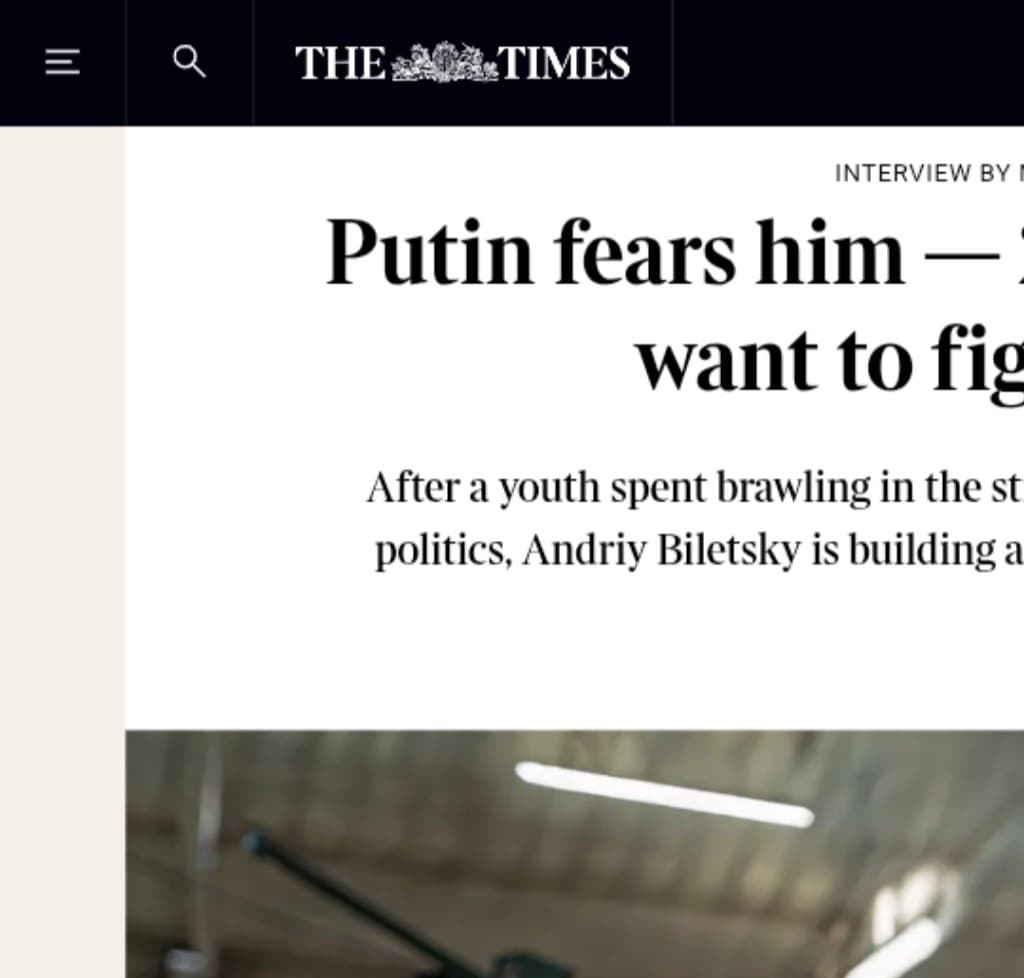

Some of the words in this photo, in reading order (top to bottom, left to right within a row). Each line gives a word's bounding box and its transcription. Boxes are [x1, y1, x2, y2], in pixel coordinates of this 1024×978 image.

[295, 45, 387, 81] THE
[497, 45, 631, 81] TIMES
[836, 164, 971, 182] INTERVIEW
[981, 164, 1010, 182] BY
[326, 217, 535, 285] Putin
[553, 217, 736, 286] fears
[756, 217, 906, 284] him
[633, 331, 818, 392] want
[837, 331, 913, 392] to
[366, 469, 461, 502] After
[470, 479, 489, 502] a
[499, 470, 600, 510] youth
[612, 473, 707, 510] spent
[717, 469, 871, 510] brawling
[880, 469, 915, 502] in
[925, 469, 982, 502] the
[376, 532, 512, 573] politics,
[522, 532, 648, 573] Andriy
[658, 531, 802, 572] Biletsky
[813, 532, 839, 565] is
[849, 532, 996, 572] building
[1005, 541, 1024, 565] a
